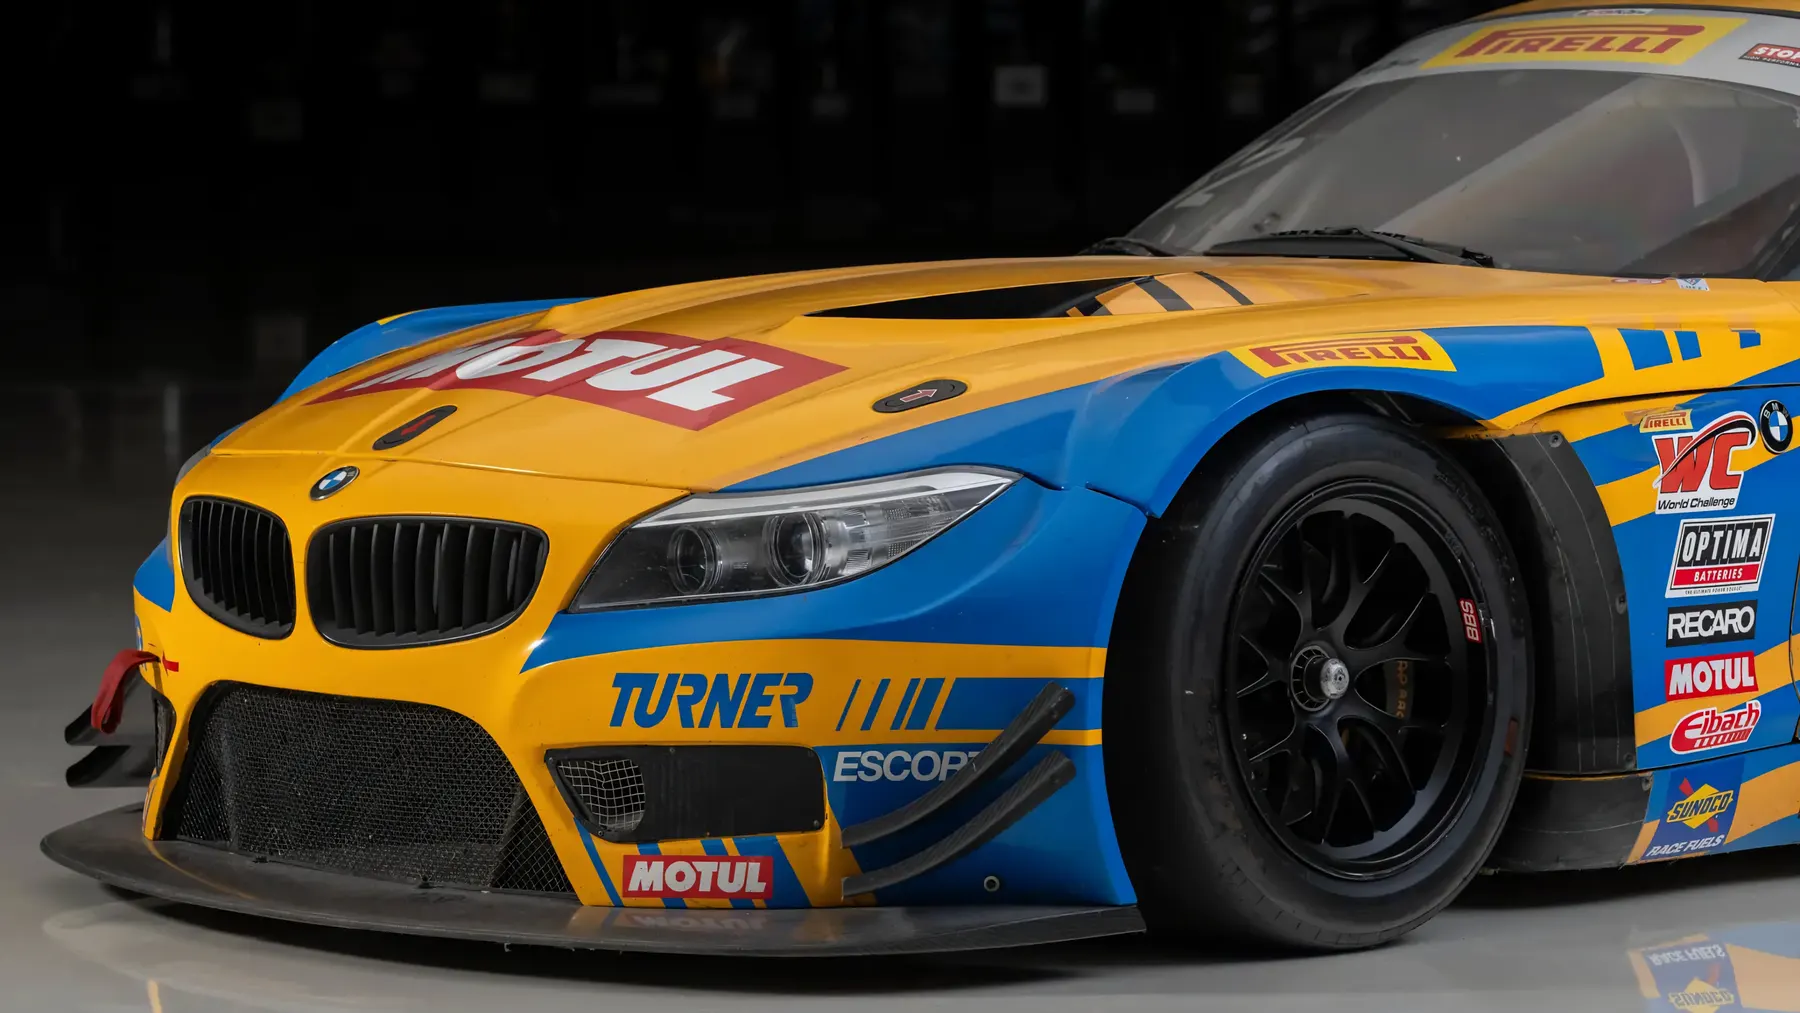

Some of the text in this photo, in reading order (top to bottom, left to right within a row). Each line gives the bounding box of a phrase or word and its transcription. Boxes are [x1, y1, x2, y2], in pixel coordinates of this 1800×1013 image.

[1453, 24, 1706, 58] PIRELLI
[1249, 335, 1432, 368] PIRELLI
[345, 337, 784, 411] MOTUL
[1643, 411, 1687, 429] PIRELLI
[1654, 431, 1750, 494] WC
[1658, 497, 1735, 510] World Challenge
[1682, 527, 1761, 563] OPTIMA
[1694, 568, 1743, 582] BATTERIES
[1460, 600, 1479, 641] BBS
[1667, 606, 1755, 640] RECARO
[1669, 660, 1755, 696] MOTUL
[609, 672, 814, 729] TURNER
[1672, 703, 1761, 745] Eibach
[833, 750, 978, 783] ESCOR
[1669, 791, 1733, 821] SUNOCO
[1645, 834, 1725, 857] RACE FUELS
[628, 860, 767, 894] MOTUL
